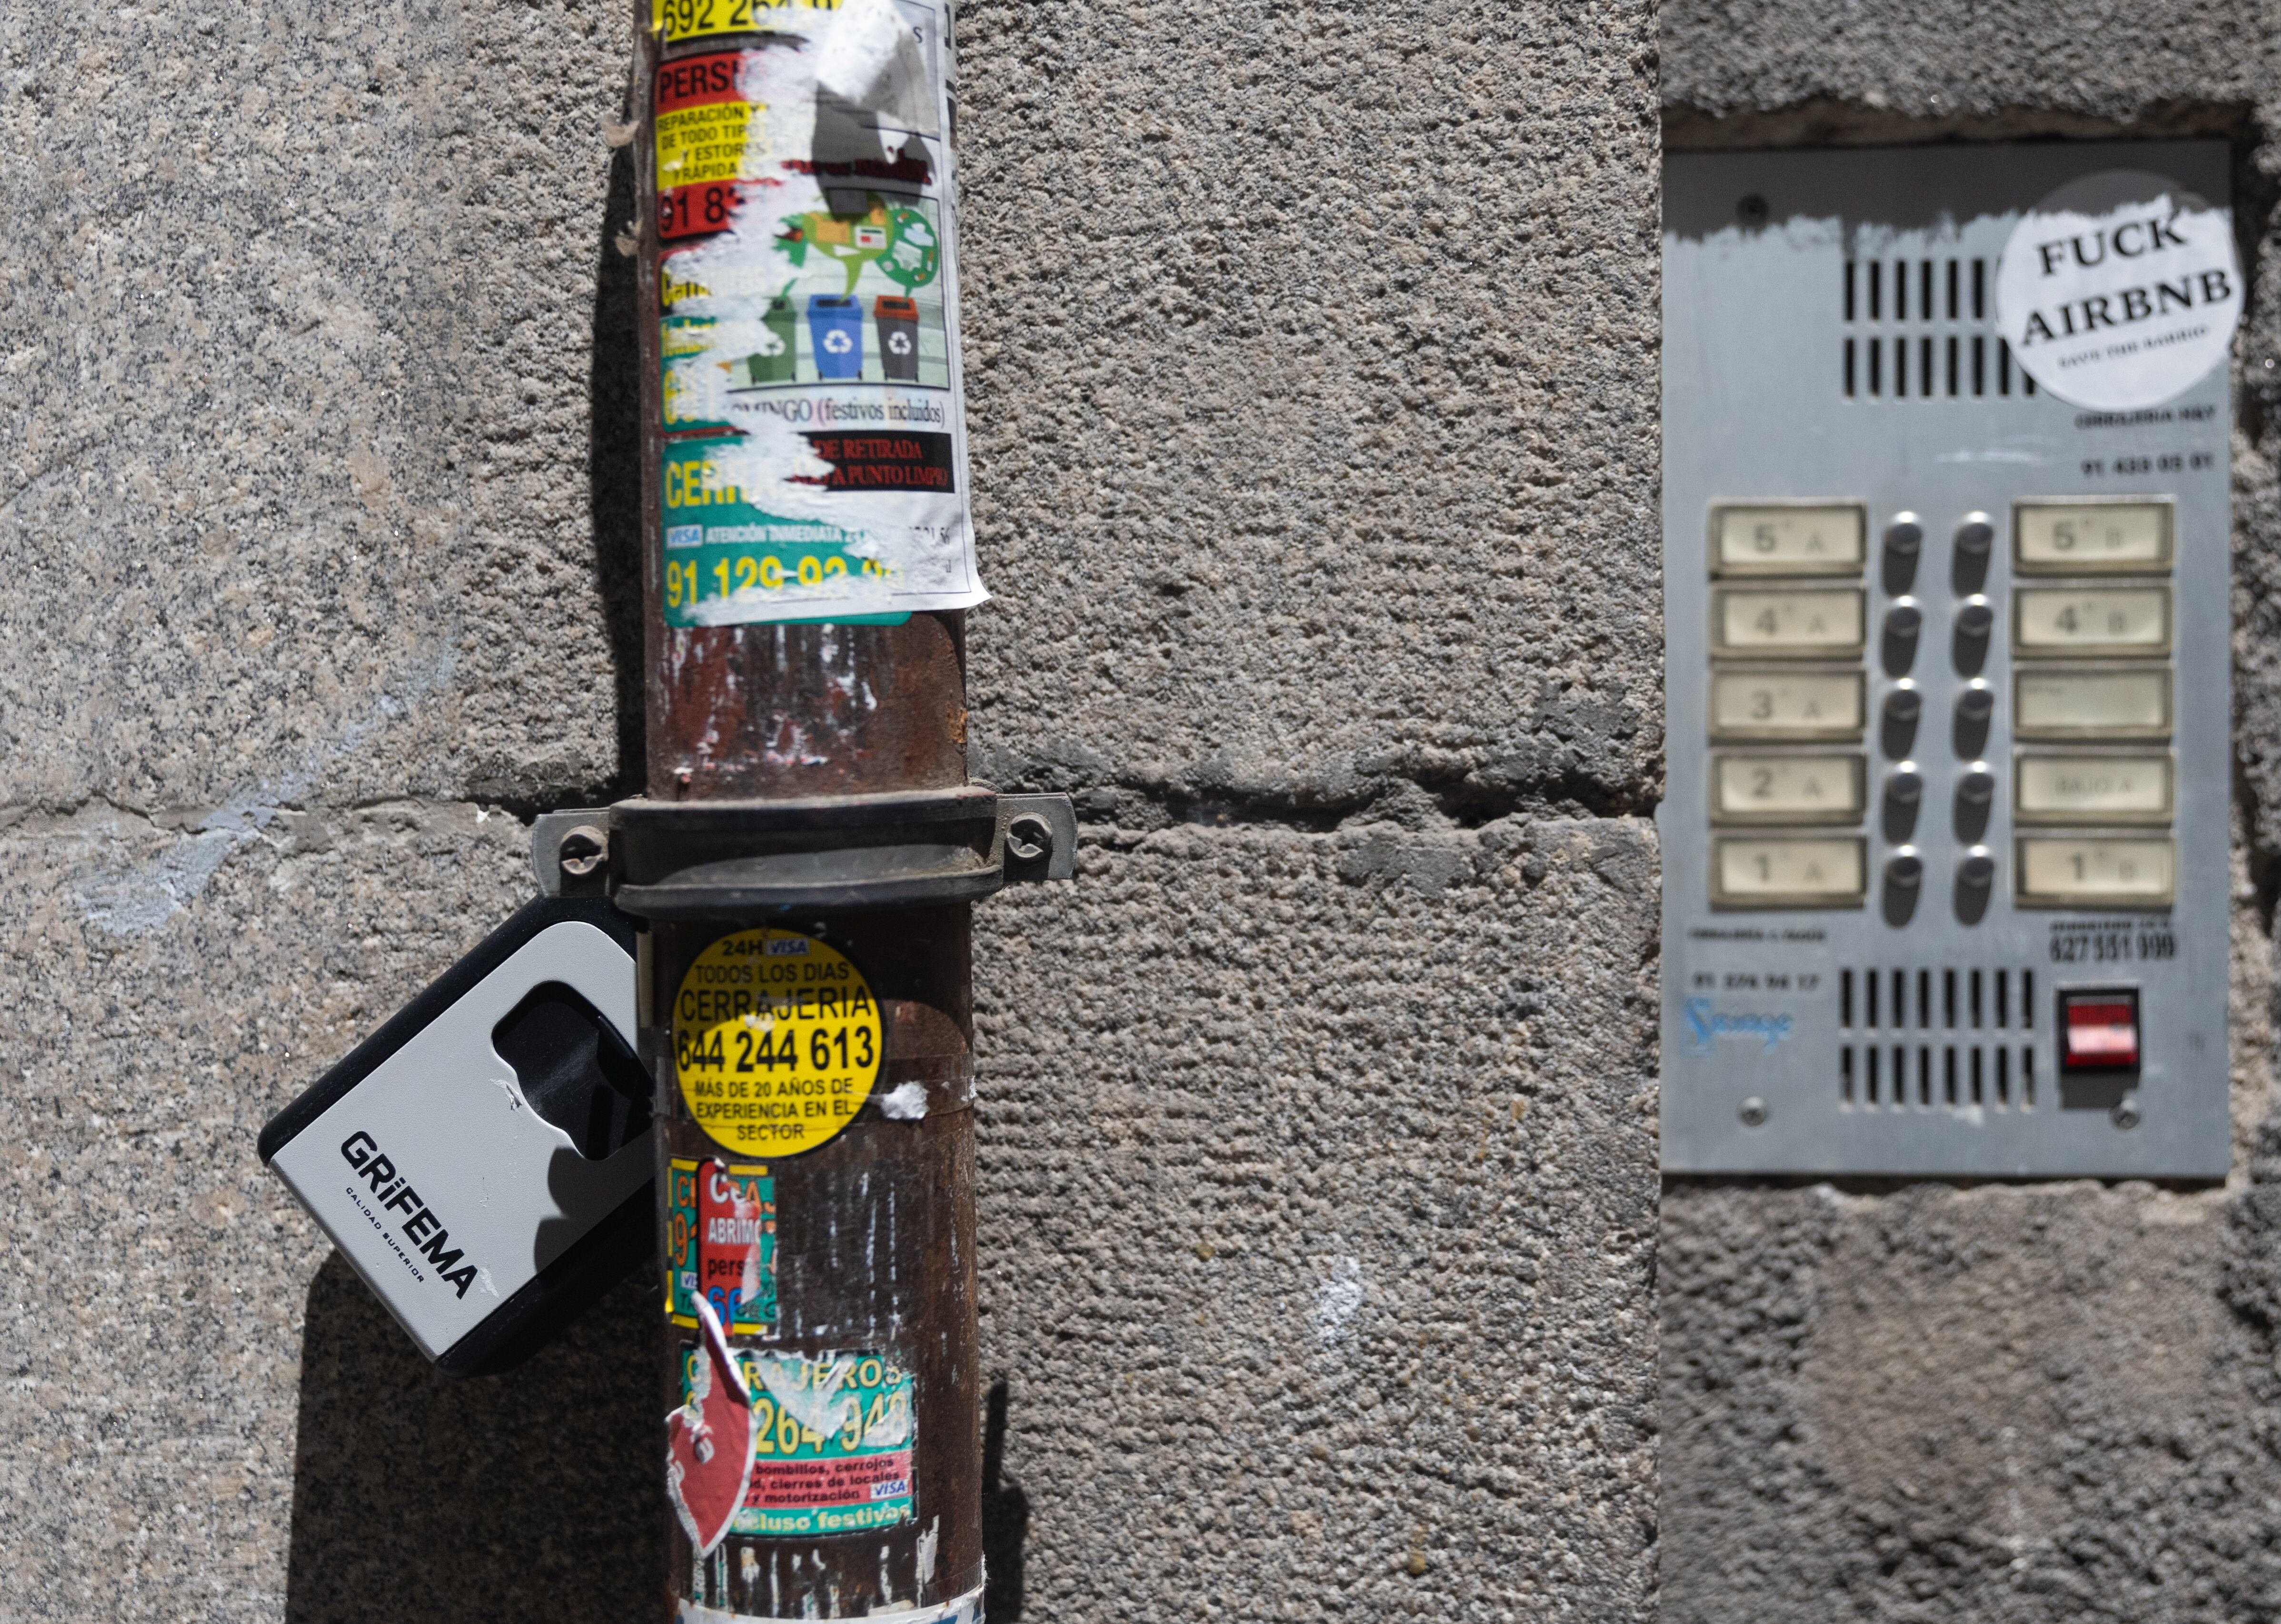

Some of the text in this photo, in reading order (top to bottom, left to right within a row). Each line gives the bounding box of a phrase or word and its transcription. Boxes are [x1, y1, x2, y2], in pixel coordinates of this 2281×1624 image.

[680, 126, 717, 144] TODO
[2036, 218, 2186, 278] FUCK
[2020, 269, 2232, 348] AIRBNB
[817, 398, 884, 428] (festivos
[888, 397, 945, 429] incluidos)
[842, 438, 924, 460] RETIRADA
[847, 464, 903, 486] PUNTO
[705, 522, 767, 544] ATENCIÓN
[767, 524, 843, 543] INMEDIATA
[667, 559, 697, 608] 91
[722, 939, 807, 956] 24H VISA
[696, 961, 849, 984] TODOS LOS DIAS
[680, 985, 872, 1022] CERRAJERIA
[677, 1025, 874, 1073] 644 244 613
[695, 1077, 854, 1097] MÁS DE 20 AÑOS DE
[696, 1099, 857, 1119] EXPERIENCIA EN EL
[736, 1124, 805, 1141] SECTOR
[346, 1187, 425, 1283] CALIDAD SUPERIOR
[835, 1457, 894, 1473] cerrojos
[771, 1476, 821, 1489] cierres
[828, 1475, 846, 1487] de
[850, 1470, 900, 1485] locales
[765, 1490, 860, 1503] motorización
[875, 1481, 906, 1496] VISA
[817, 1504, 911, 1529] festivos
